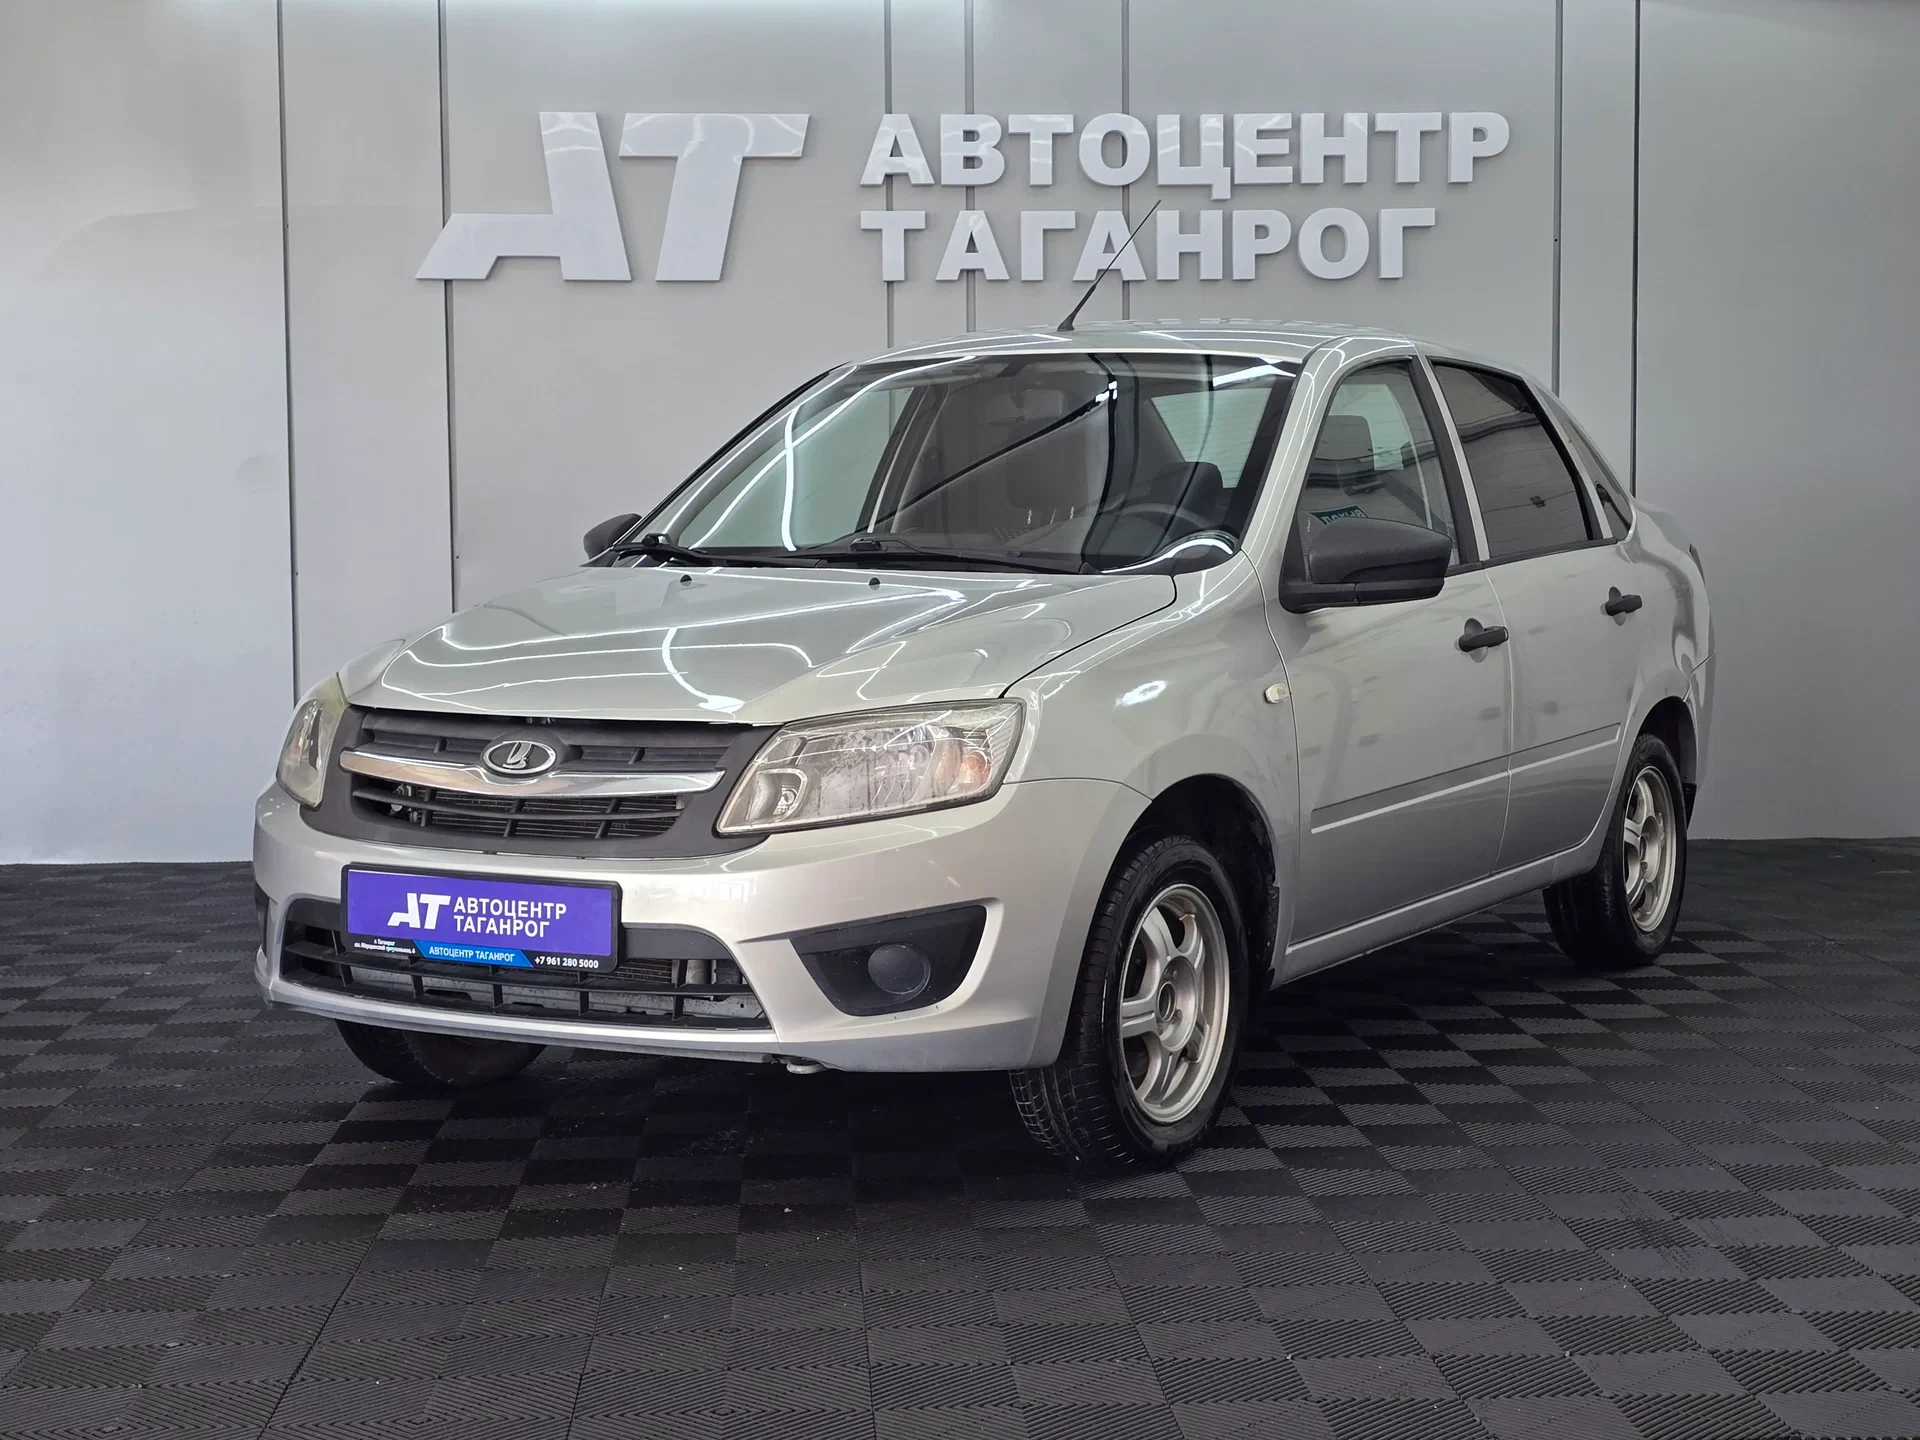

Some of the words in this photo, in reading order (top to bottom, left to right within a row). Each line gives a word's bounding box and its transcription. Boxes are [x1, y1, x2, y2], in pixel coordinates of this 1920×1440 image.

[860, 112, 1510, 200] АВТОЦЕНТР
[860, 207, 1436, 281] ТАГАНРОГ
[453, 896, 567, 920] АВТОЦЕНТР
[453, 915, 550, 938] ТАГАНРОГ
[429, 946, 474, 958] АВТОЦЕНТР
[475, 950, 515, 962] ТАГАНРОГ
[534, 956, 546, 965] +7
[546, 957, 560, 966] 961
[562, 958, 578, 967] 280
[578, 959, 599, 968] 5000
